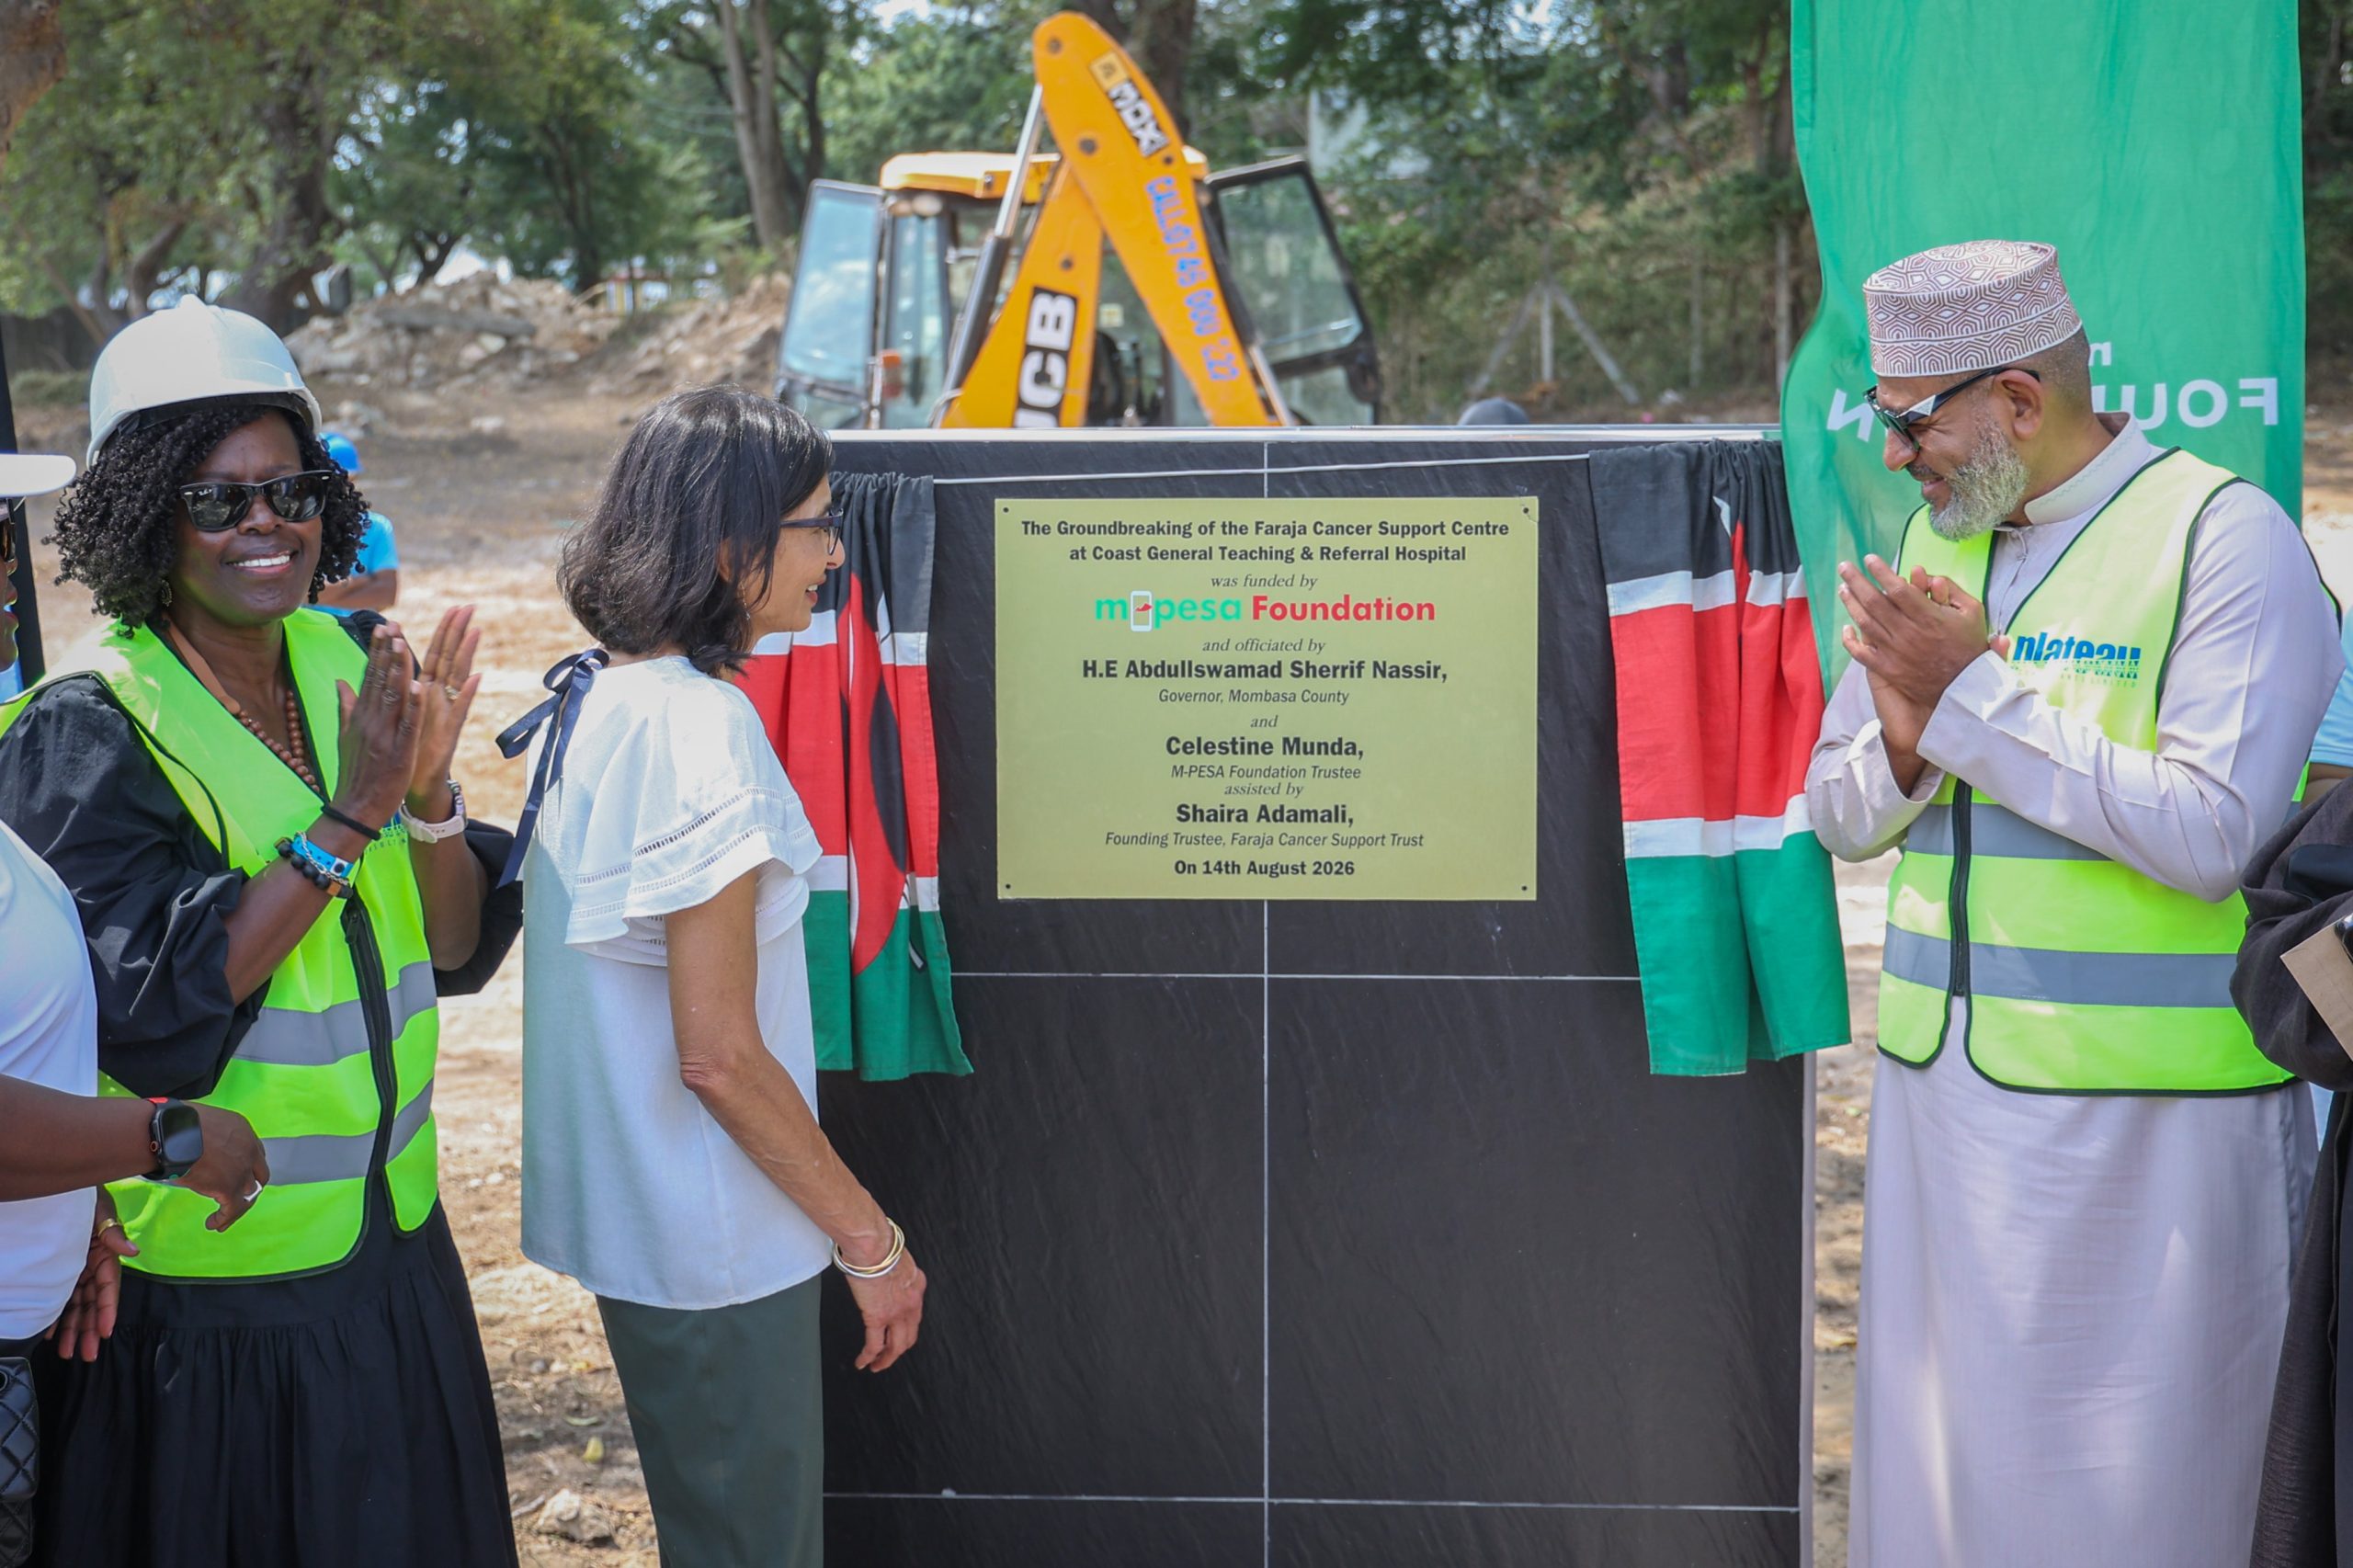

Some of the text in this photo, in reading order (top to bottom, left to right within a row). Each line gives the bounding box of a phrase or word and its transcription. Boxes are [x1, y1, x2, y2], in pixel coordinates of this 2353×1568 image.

[1021, 519, 1509, 540] The Groundbreaking of the Faraja Cancer Support Centre
[1069, 545, 1466, 563] at Coast General Teaching & Referral Hospital
[1211, 574, 1317, 590] was funded by
[1251, 594, 1437, 622] Foundation
[1202, 638, 1325, 654] and officiated by
[1082, 660, 1448, 683] H.E Abdullswamad Sherrif Nassir,
[1158, 689, 1349, 705] Governor, Mombasa County
[1250, 715, 1279, 727] and
[1165, 735, 1364, 760] Celestine Munda,
[1171, 765, 1361, 778] M-PESA Foundation Trustee
[1224, 782, 1303, 798] assisted by
[1176, 803, 1354, 827] Shaira Adamali,
[1105, 832, 1425, 848] Founding Trustee, Faraja Cancer Support Trust
[1174, 860, 1356, 878] On 14th August 2026
